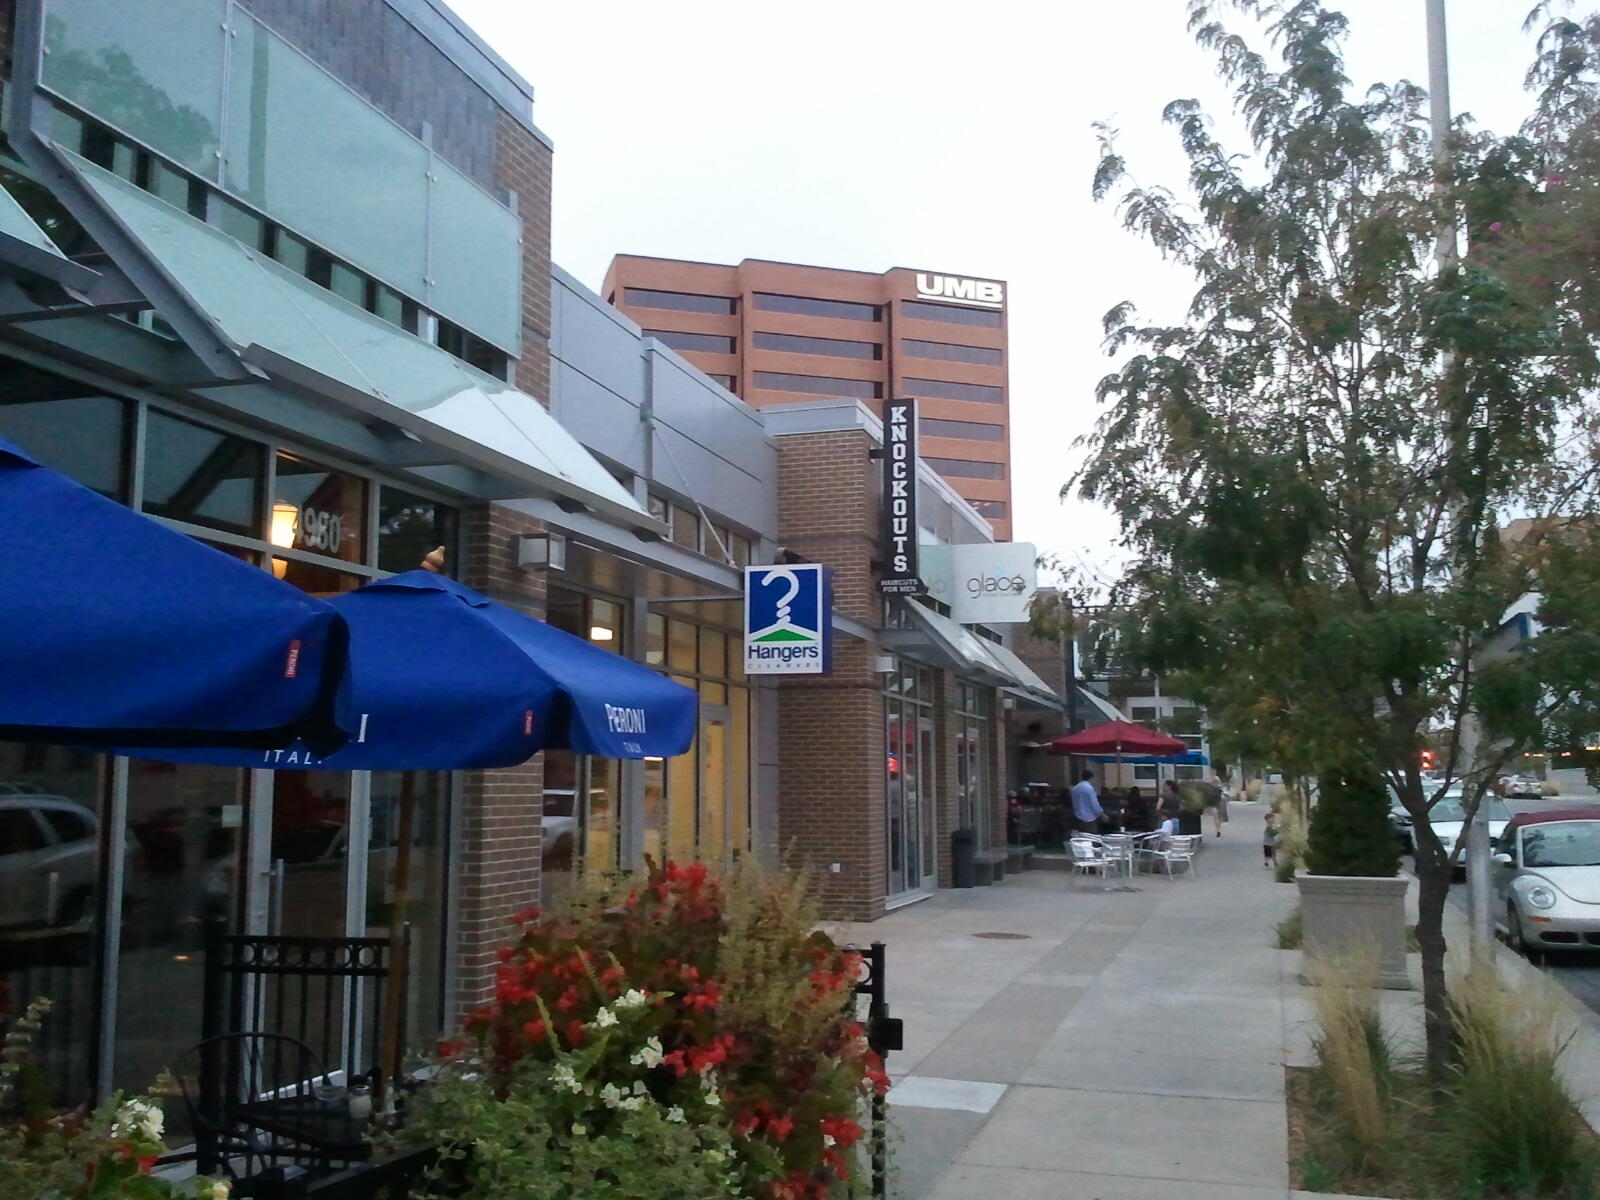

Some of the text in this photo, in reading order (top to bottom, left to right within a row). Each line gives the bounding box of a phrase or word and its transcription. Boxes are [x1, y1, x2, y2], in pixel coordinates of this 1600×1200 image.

[916, 273, 1003, 303] UMB
[890, 406, 909, 573] KNOCKOUTS
[748, 645, 819, 662] Hangers
[604, 703, 646, 734] PERONI
[264, 749, 322, 765] ITAL
